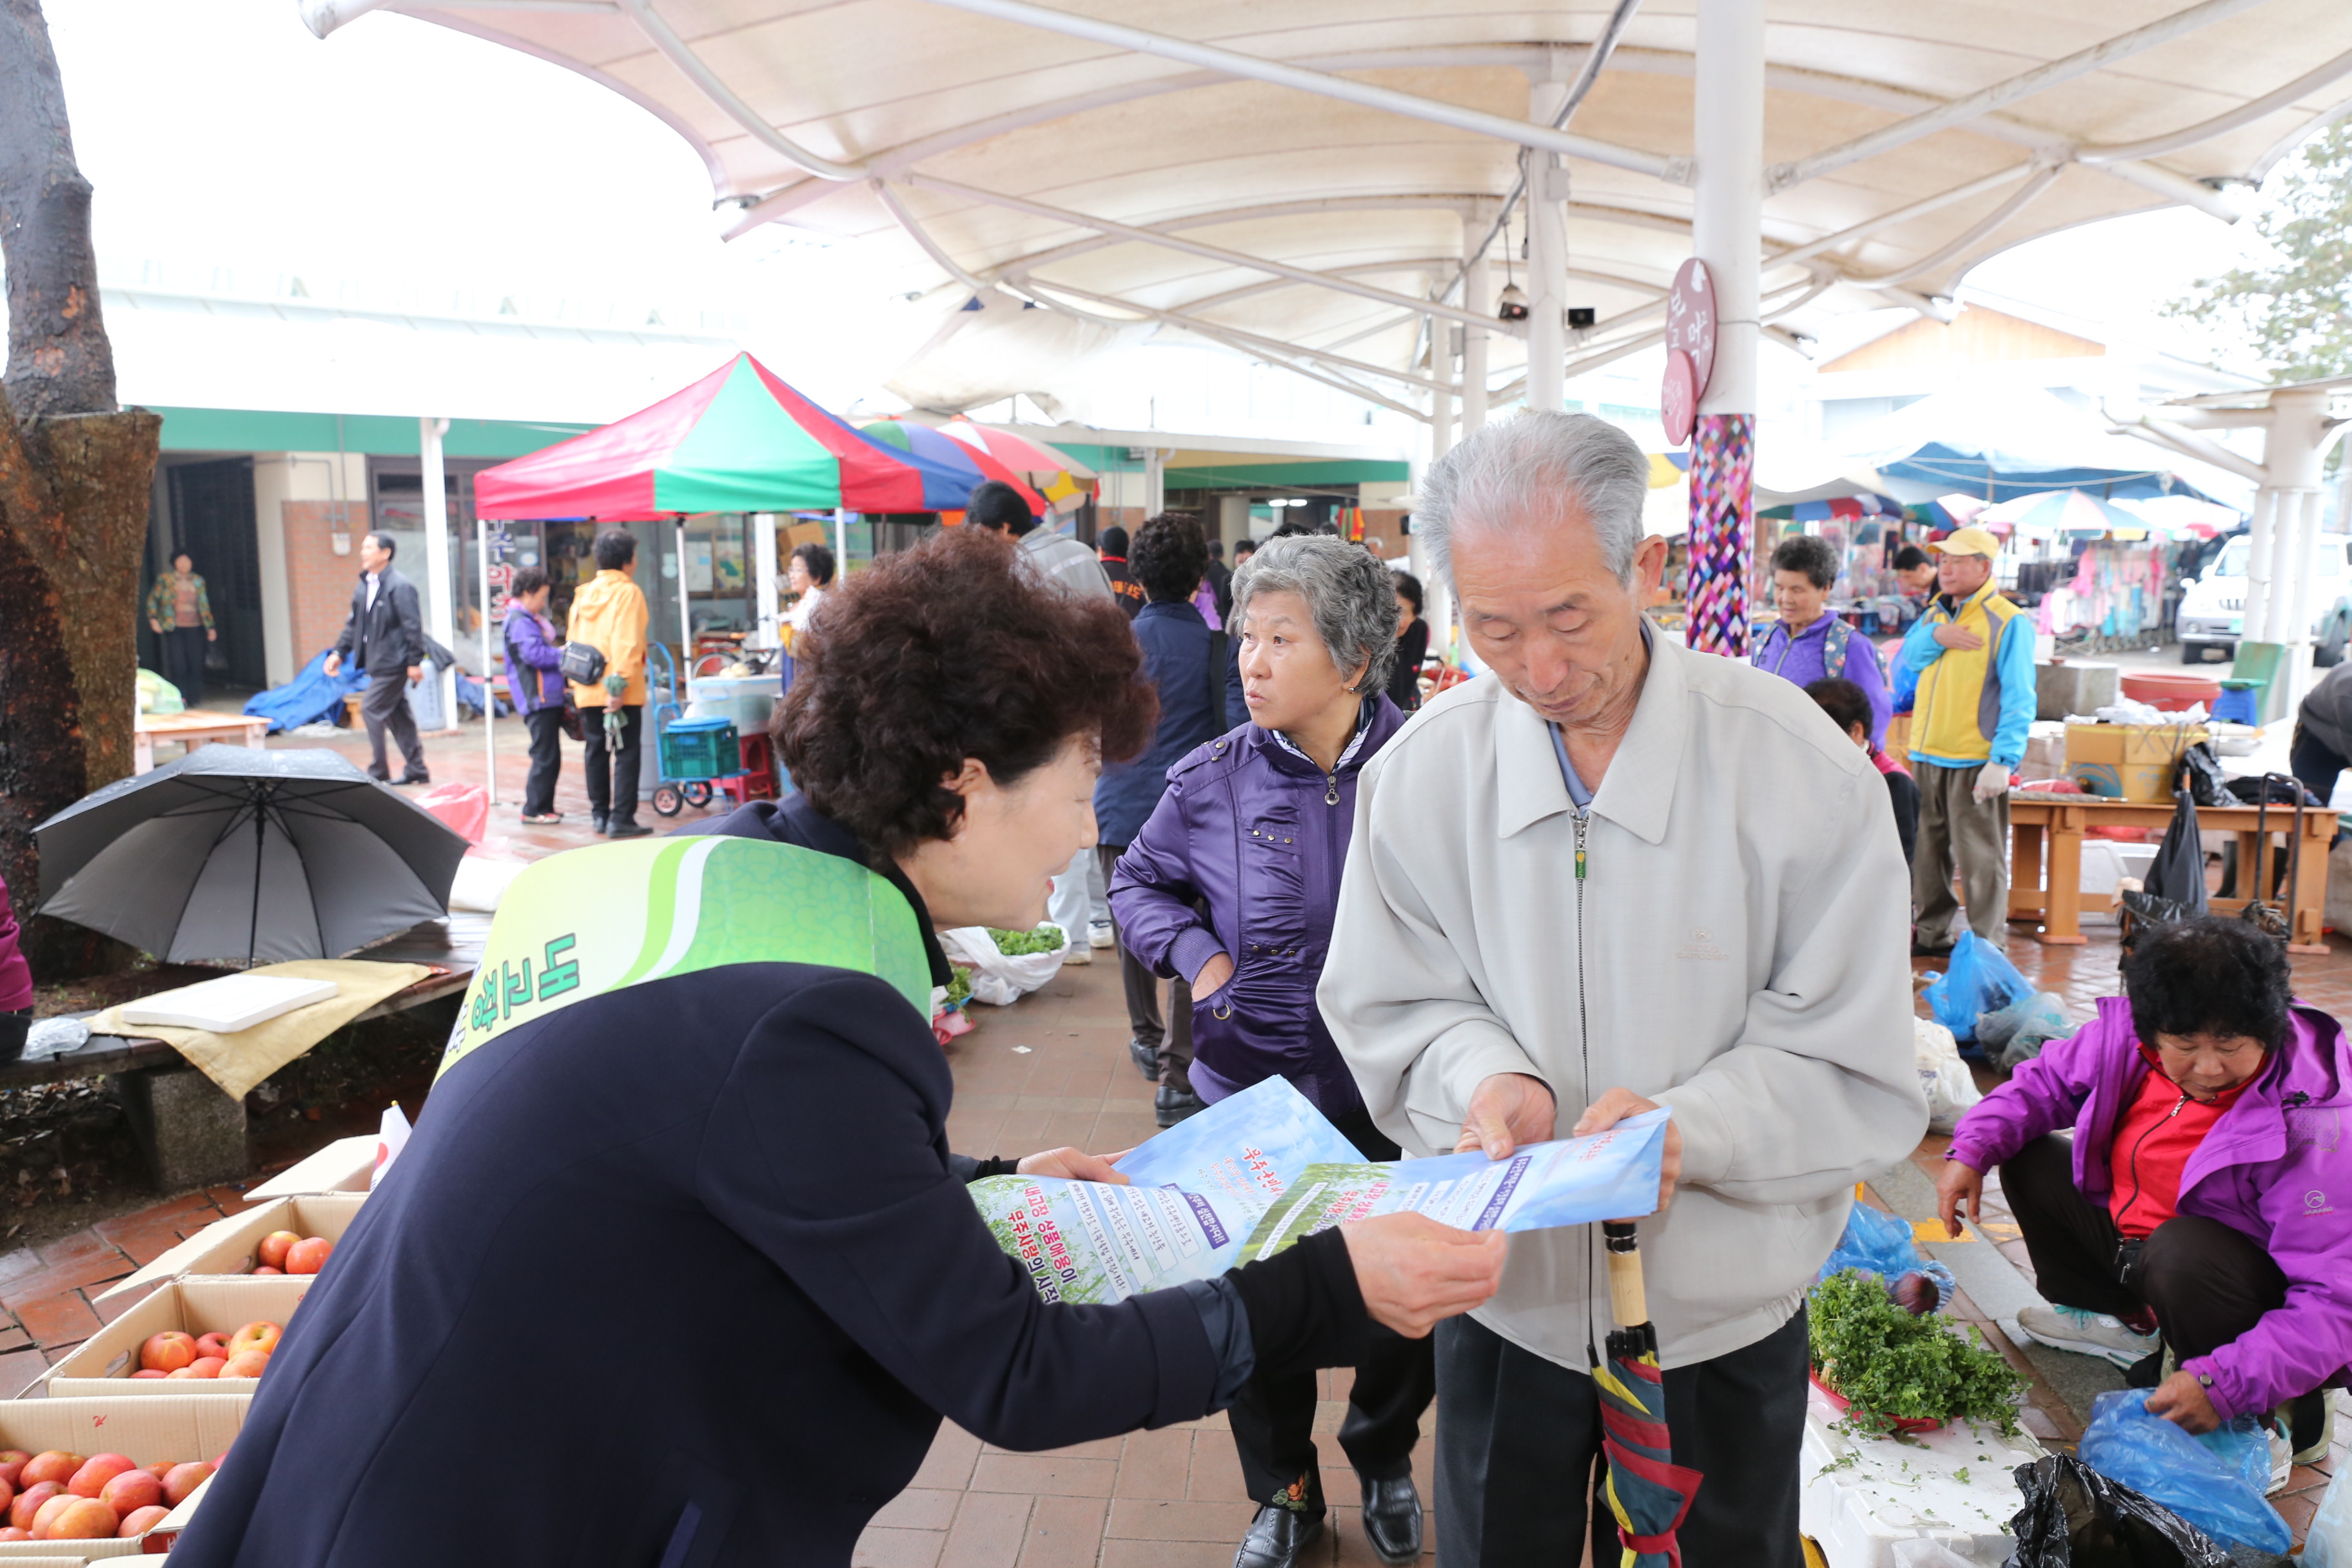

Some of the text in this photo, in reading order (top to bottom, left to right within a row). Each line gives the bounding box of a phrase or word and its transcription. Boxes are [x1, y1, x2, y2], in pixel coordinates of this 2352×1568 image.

[471, 933, 580, 1032] 내고장
[1008, 1210, 1060, 1304] 무주사랑의 시작
[1024, 1186, 1078, 1283] 내고장 상품애용이
[1199, 1206, 1226, 1244] 실천합시다!!
